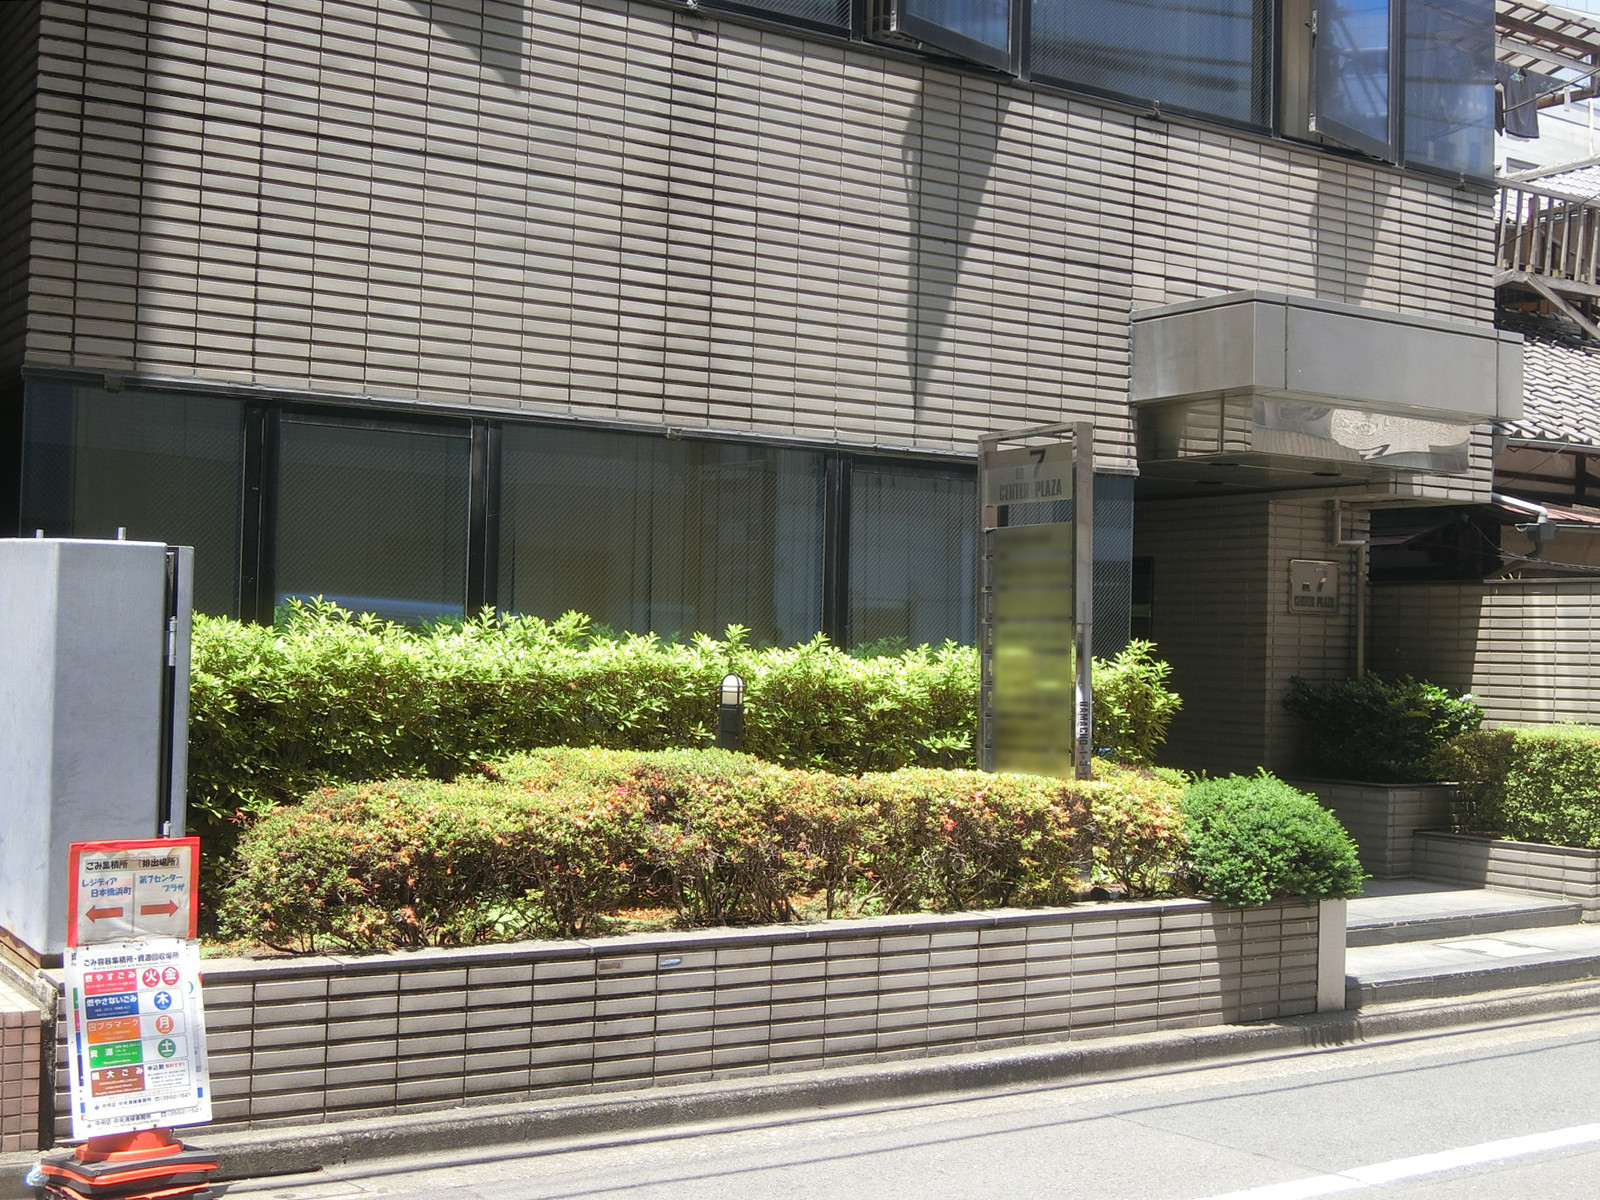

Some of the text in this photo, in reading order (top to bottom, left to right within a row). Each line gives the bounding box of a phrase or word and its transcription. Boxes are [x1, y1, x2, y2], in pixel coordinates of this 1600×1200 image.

[1029, 448, 1046, 478] 7
[1000, 479, 1062, 500] CENTER PLAZA
[1079, 701, 1089, 745] HAMACHO
[86, 859, 128, 871] ごみ集積所
[145, 970, 157, 983] 火
[164, 967, 177, 980] 金
[156, 992, 169, 1005] 木
[160, 1017, 170, 1029] 月
[161, 1040, 173, 1053] 土
